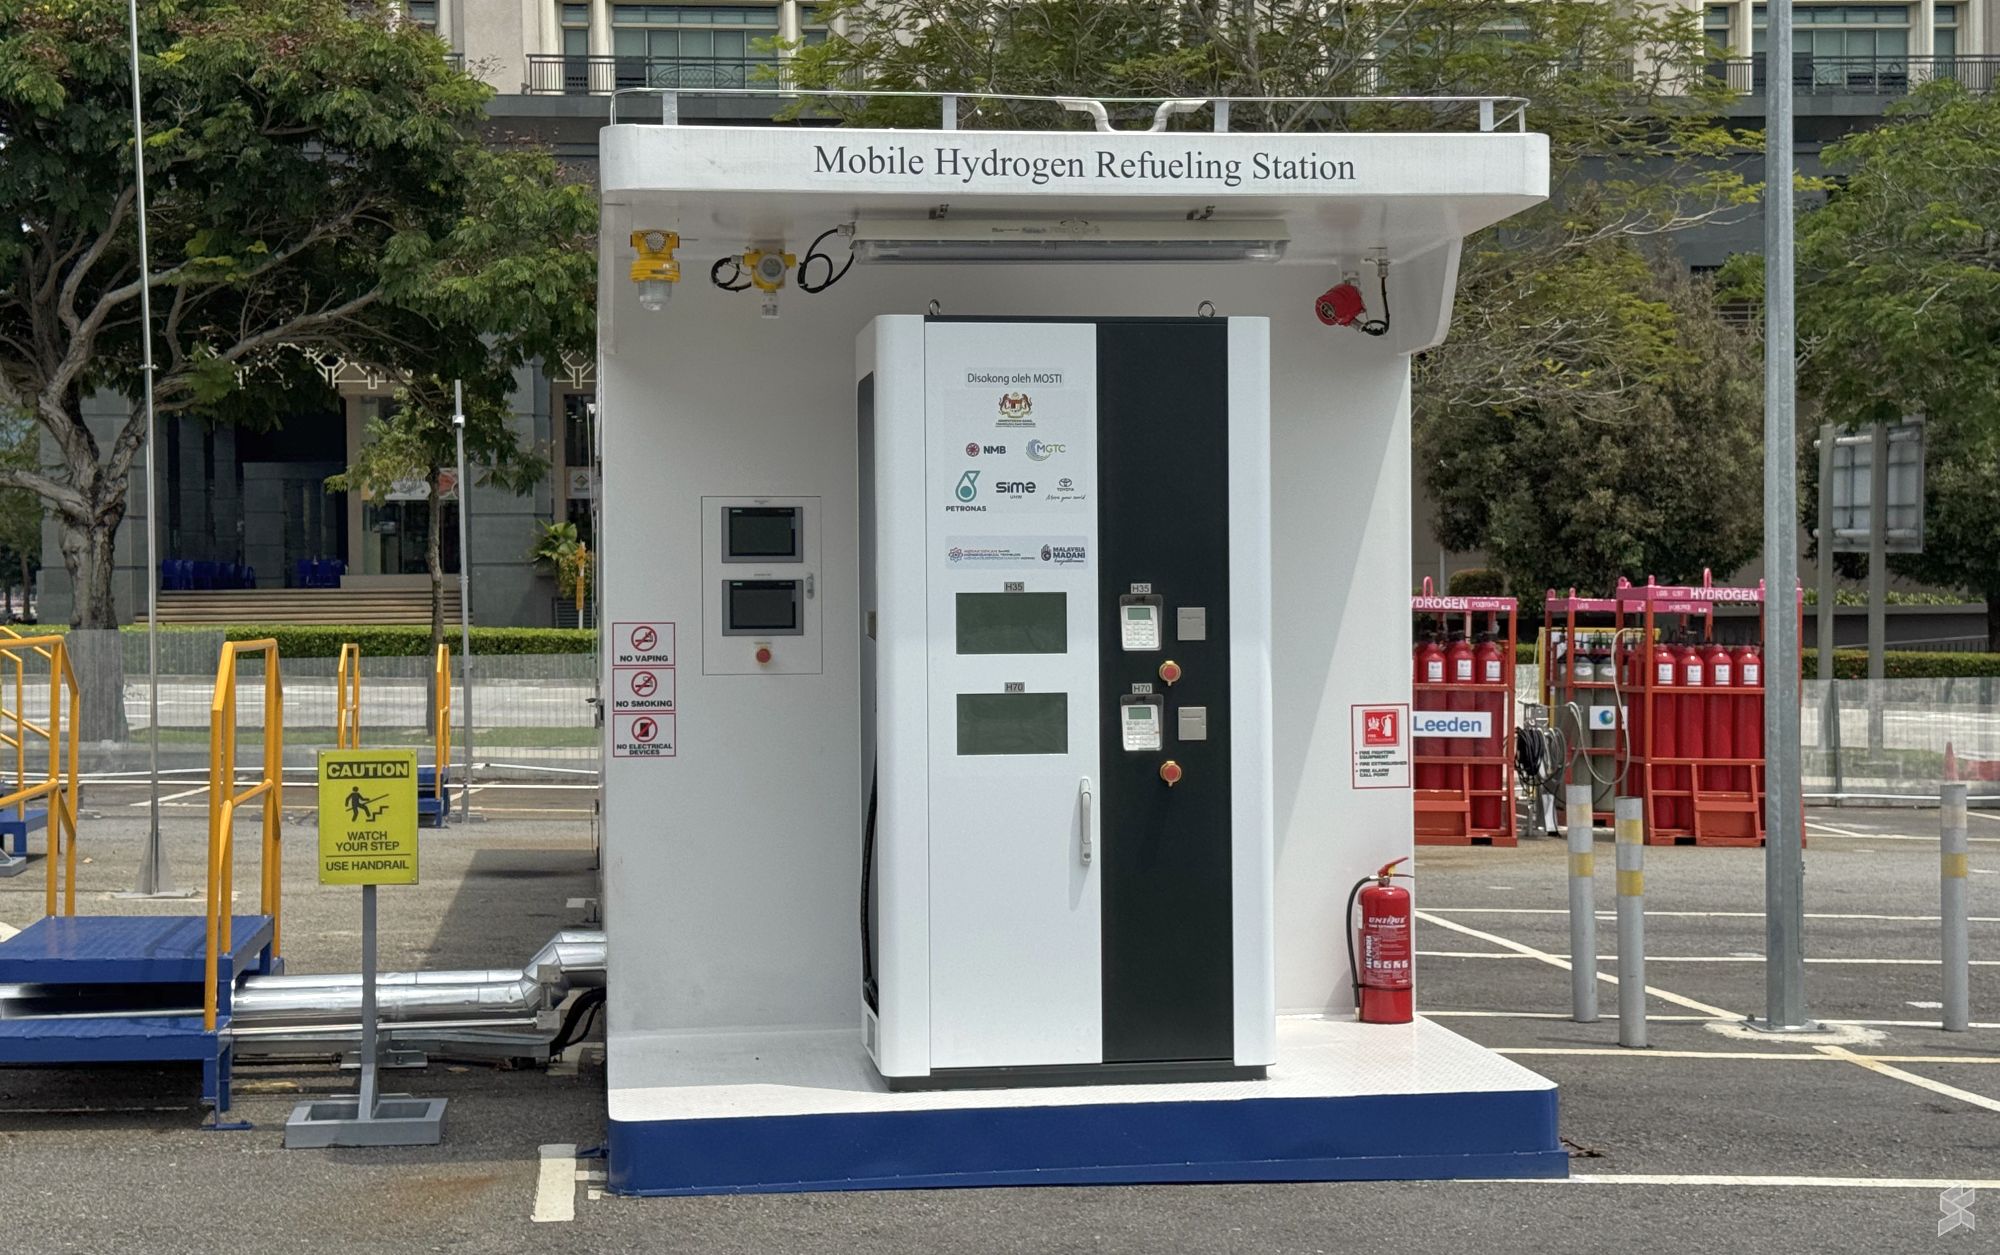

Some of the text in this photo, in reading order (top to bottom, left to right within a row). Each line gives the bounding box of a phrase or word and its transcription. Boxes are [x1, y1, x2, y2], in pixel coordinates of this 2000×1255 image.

[814, 145, 1356, 187] Mobile Hydrogen Refueling Station
[967, 373, 1062, 385] Disokong oleh MOSTI
[983, 444, 1066, 454] NMB MGTC
[995, 481, 1036, 493] sime
[1005, 582, 1023, 591] H35
[1132, 584, 1150, 593] H35
[1690, 588, 1758, 600] HYDROGEN
[1411, 597, 1468, 609] YDROGEN
[1006, 683, 1024, 692] H70
[1133, 684, 1151, 693] H70
[1413, 715, 1482, 732] Leeden
[327, 762, 409, 778] CAUTION
[347, 831, 388, 841] WATCH
[336, 841, 400, 852] YOUR STEP
[326, 860, 409, 871] USE HANDRAIL
